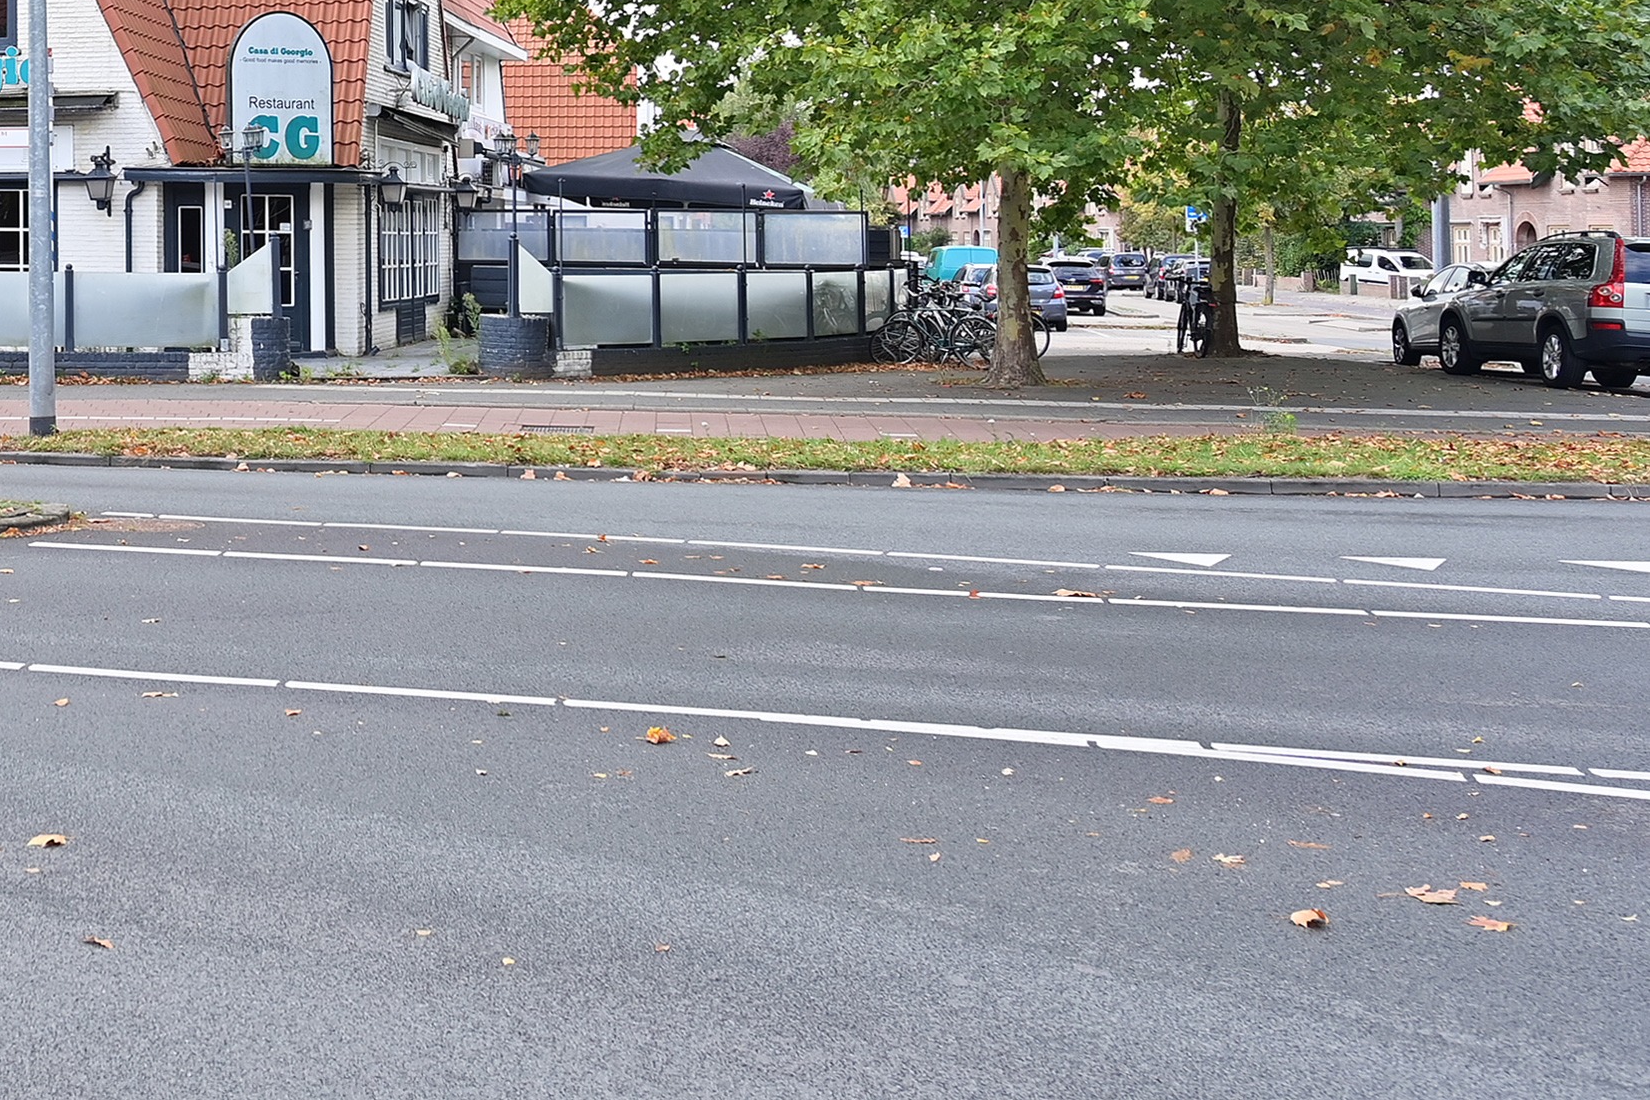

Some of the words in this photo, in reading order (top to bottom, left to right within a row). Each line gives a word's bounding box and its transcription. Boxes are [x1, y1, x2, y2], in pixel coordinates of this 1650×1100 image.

[248, 47, 269, 55] Casa
[271, 47, 278, 55] di
[249, 97, 315, 110] Restaurant
[248, 115, 320, 159] CG
[749, 198, 785, 208] Heineken
